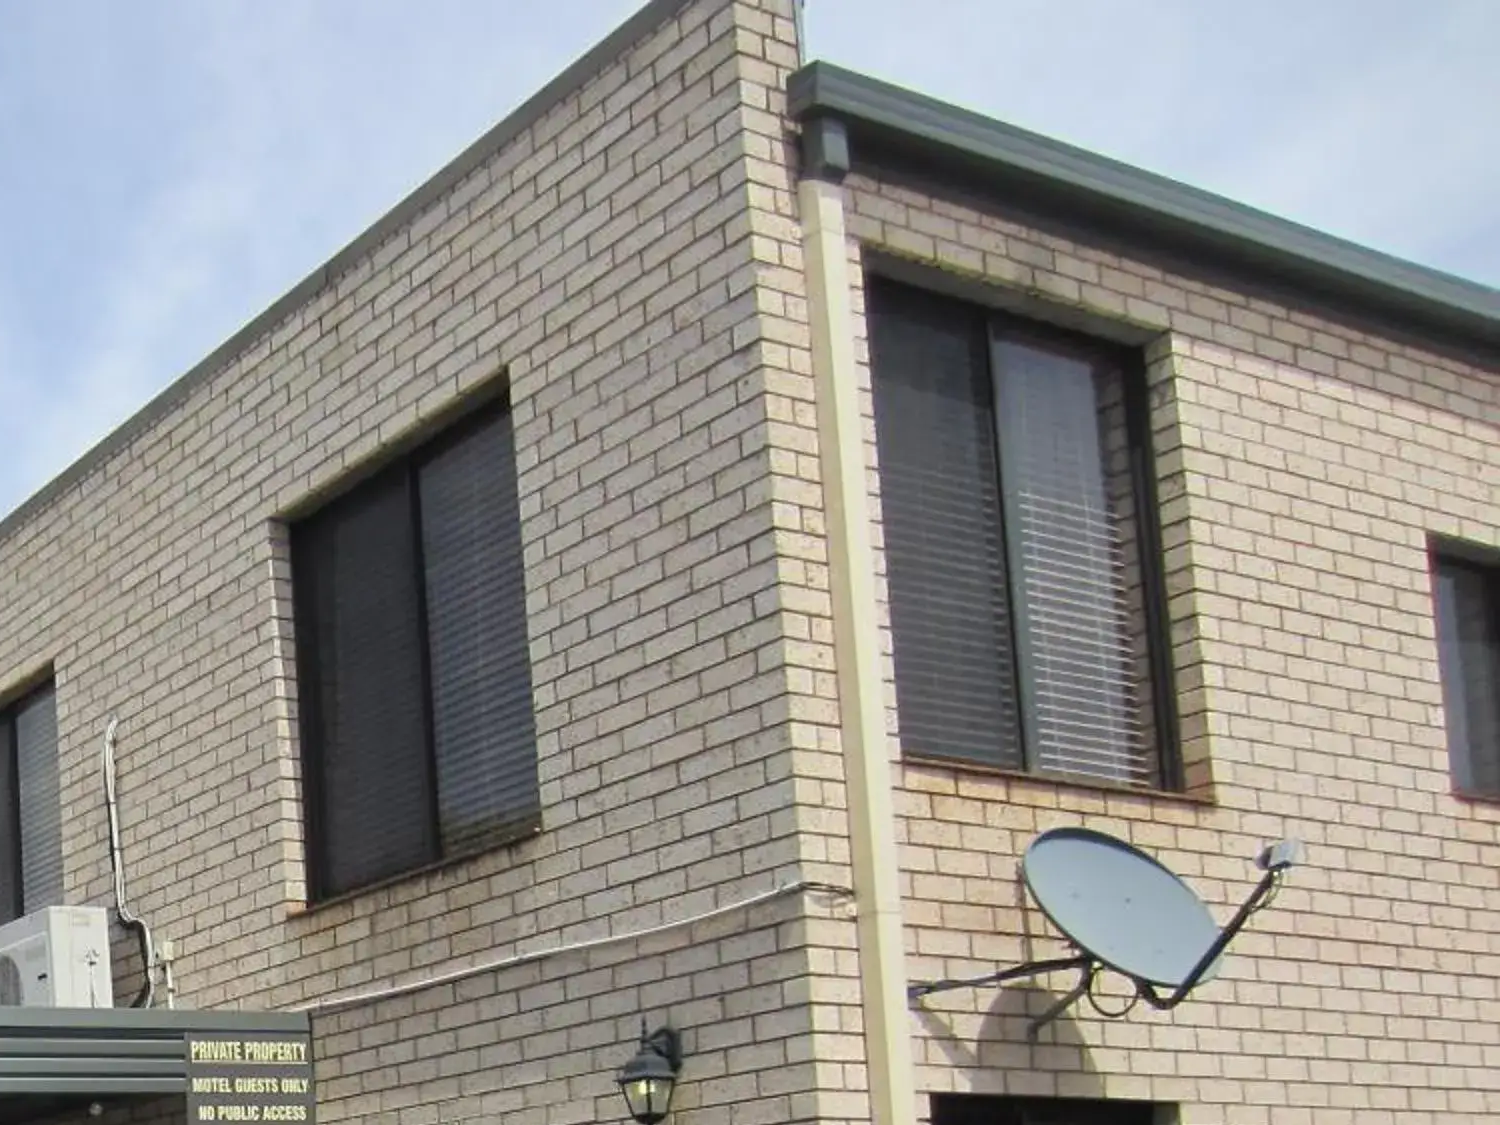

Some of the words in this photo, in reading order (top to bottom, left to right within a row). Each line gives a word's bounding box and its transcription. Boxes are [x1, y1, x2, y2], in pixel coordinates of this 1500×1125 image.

[190, 1041, 241, 1060] PRIVATE
[245, 1041, 306, 1060] PROPERTY
[192, 1077, 232, 1093] MOTEL
[235, 1077, 278, 1093] GUESTS
[281, 1078, 308, 1093] ONLY
[198, 1105, 215, 1121] NO
[217, 1105, 260, 1121] PUBLIC
[262, 1105, 306, 1121] ACCESS
